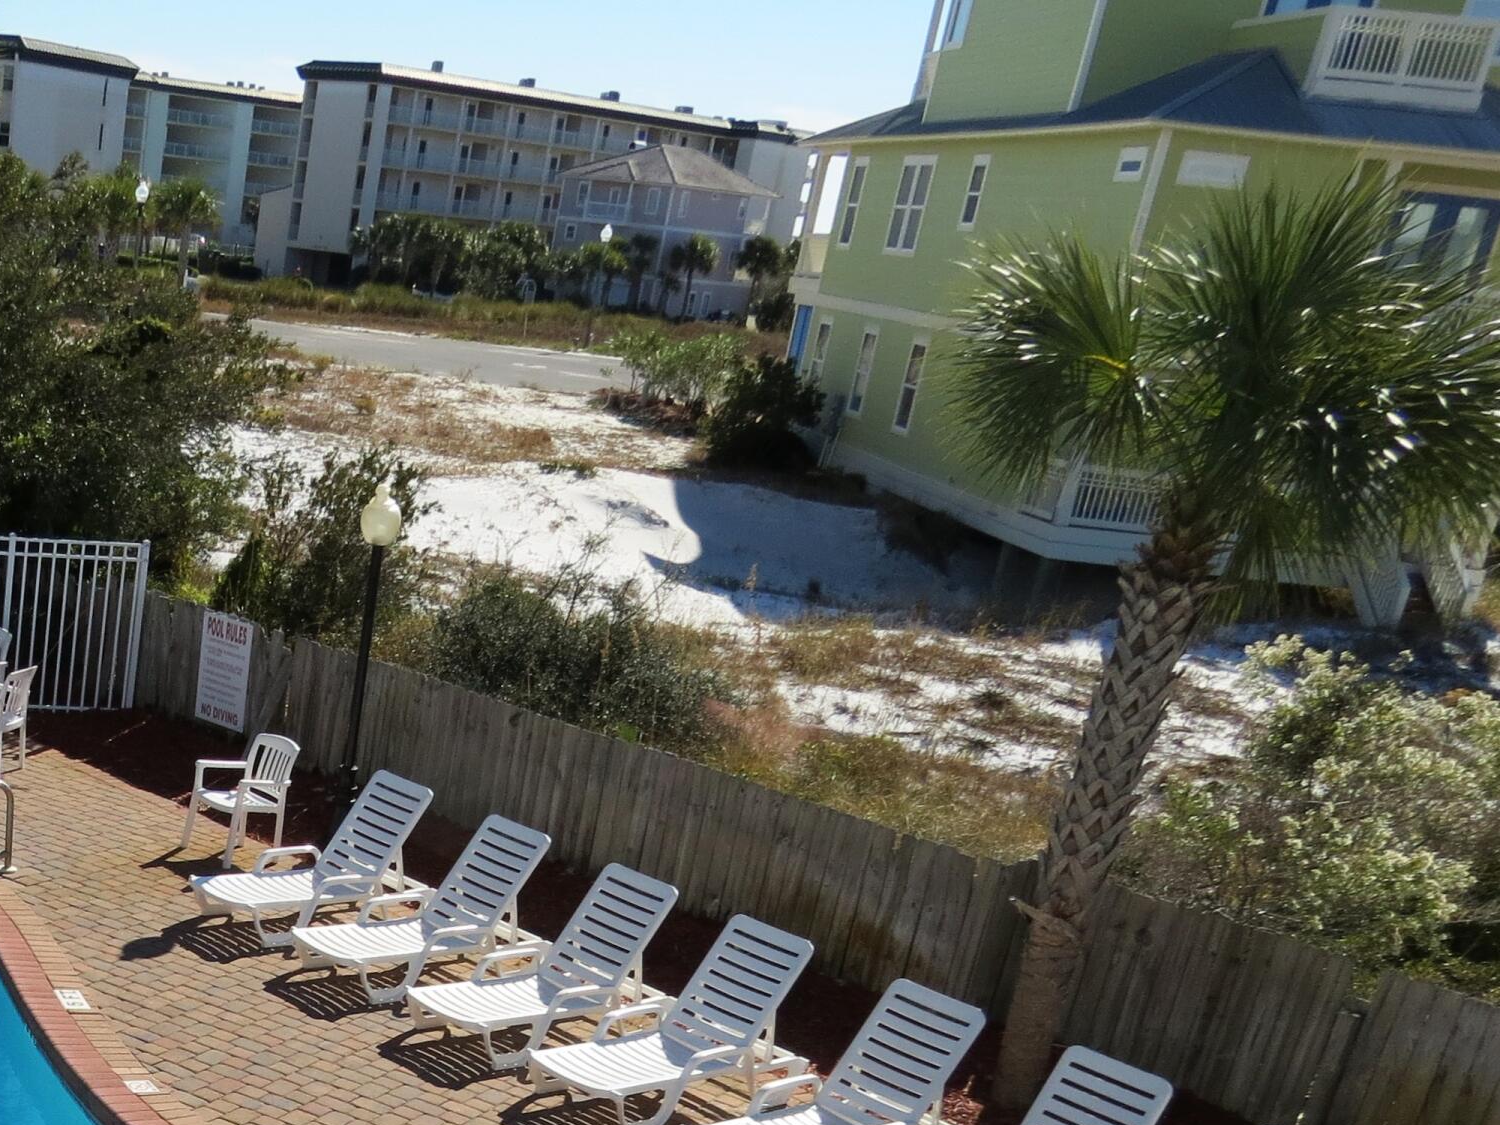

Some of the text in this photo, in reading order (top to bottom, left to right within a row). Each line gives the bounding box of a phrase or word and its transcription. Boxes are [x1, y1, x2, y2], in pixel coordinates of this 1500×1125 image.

[207, 616, 224, 639] POOL
[226, 623, 248, 646] RULES
[201, 703, 238, 726] NO DIVING
